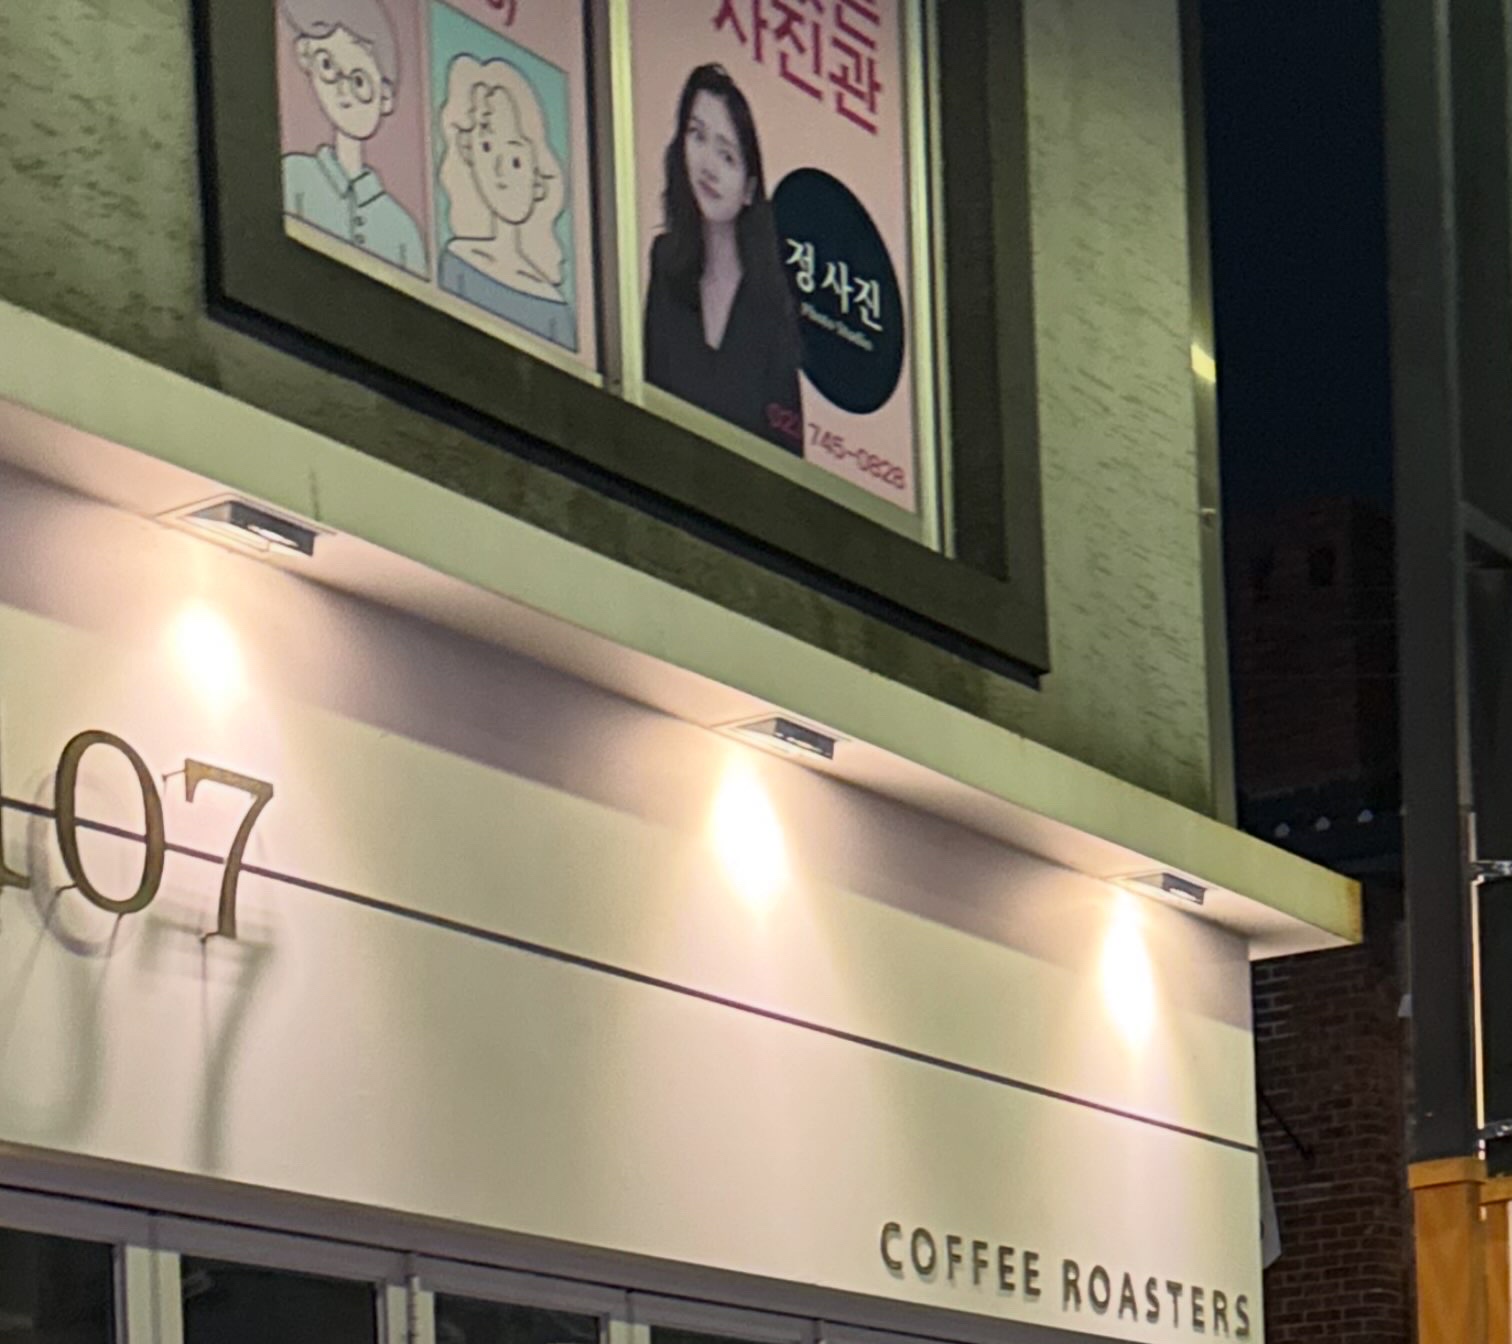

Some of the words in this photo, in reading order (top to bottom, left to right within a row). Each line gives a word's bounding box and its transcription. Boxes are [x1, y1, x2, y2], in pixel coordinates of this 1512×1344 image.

[712, 0, 882, 135] 사진관
[785, 238, 883, 332] 정사진
[880, 1221, 1042, 1298] COFFEE
[1062, 1257, 1251, 1339] ROASTERS
